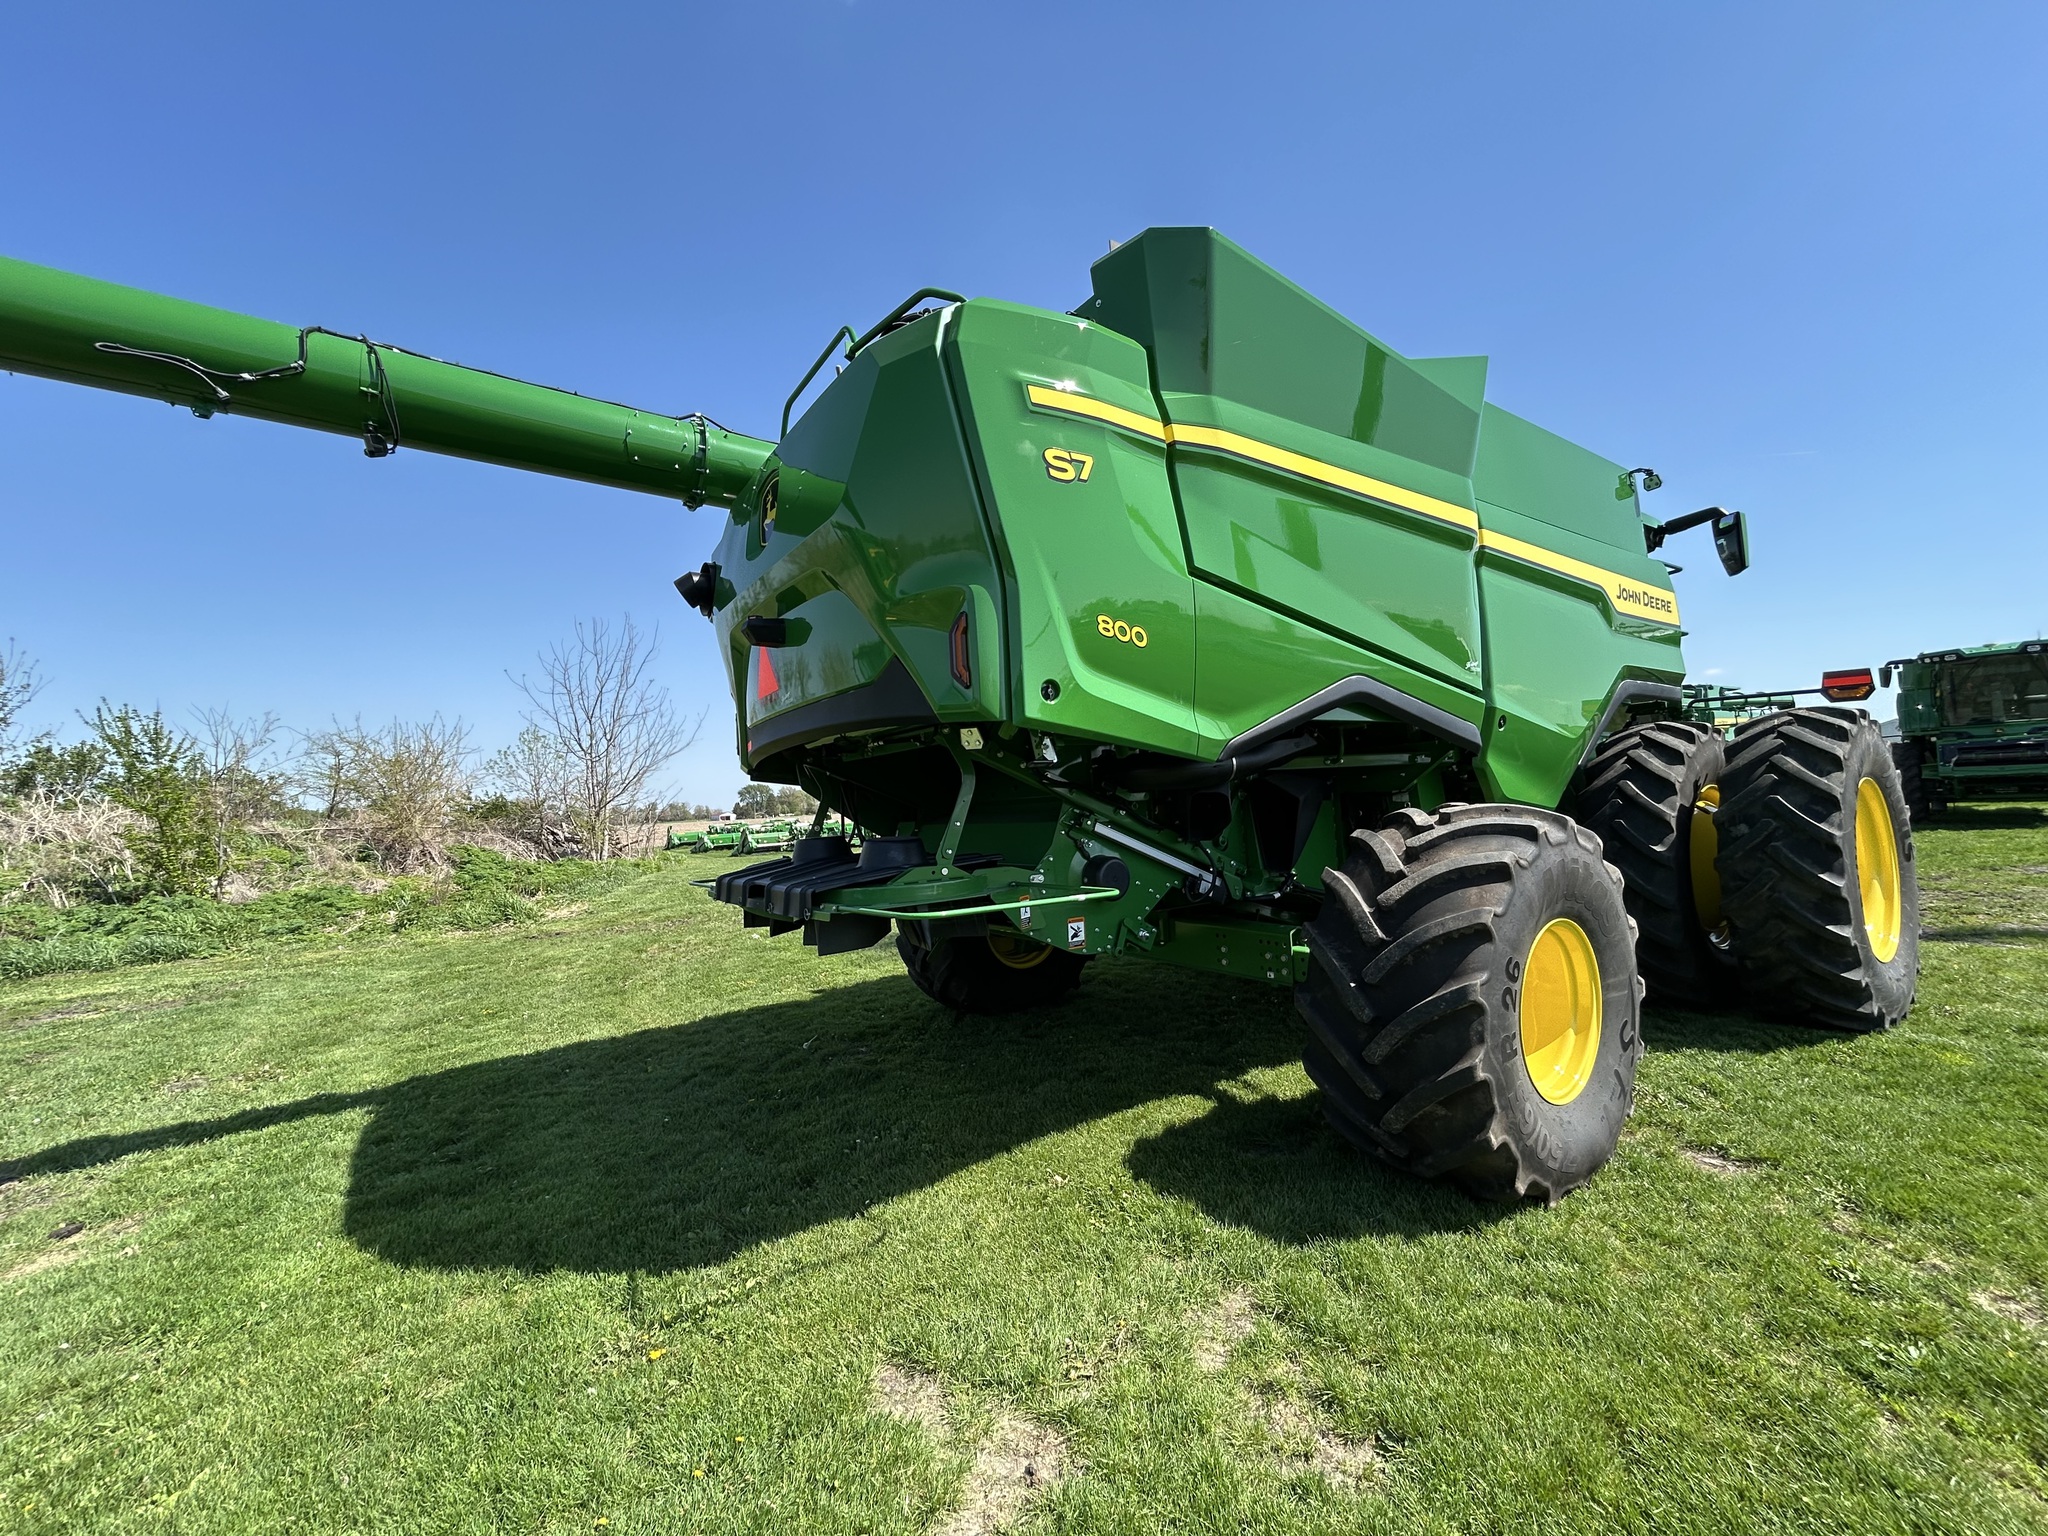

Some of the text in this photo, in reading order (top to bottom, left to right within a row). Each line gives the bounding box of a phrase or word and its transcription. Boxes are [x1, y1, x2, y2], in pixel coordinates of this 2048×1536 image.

[1043, 447, 1094, 483] S7
[1616, 584, 1672, 613] JOHN DEERE
[1096, 614, 1148, 648] 800
[1501, 956, 1520, 1013] 26
[1500, 1031, 1518, 1064] R
